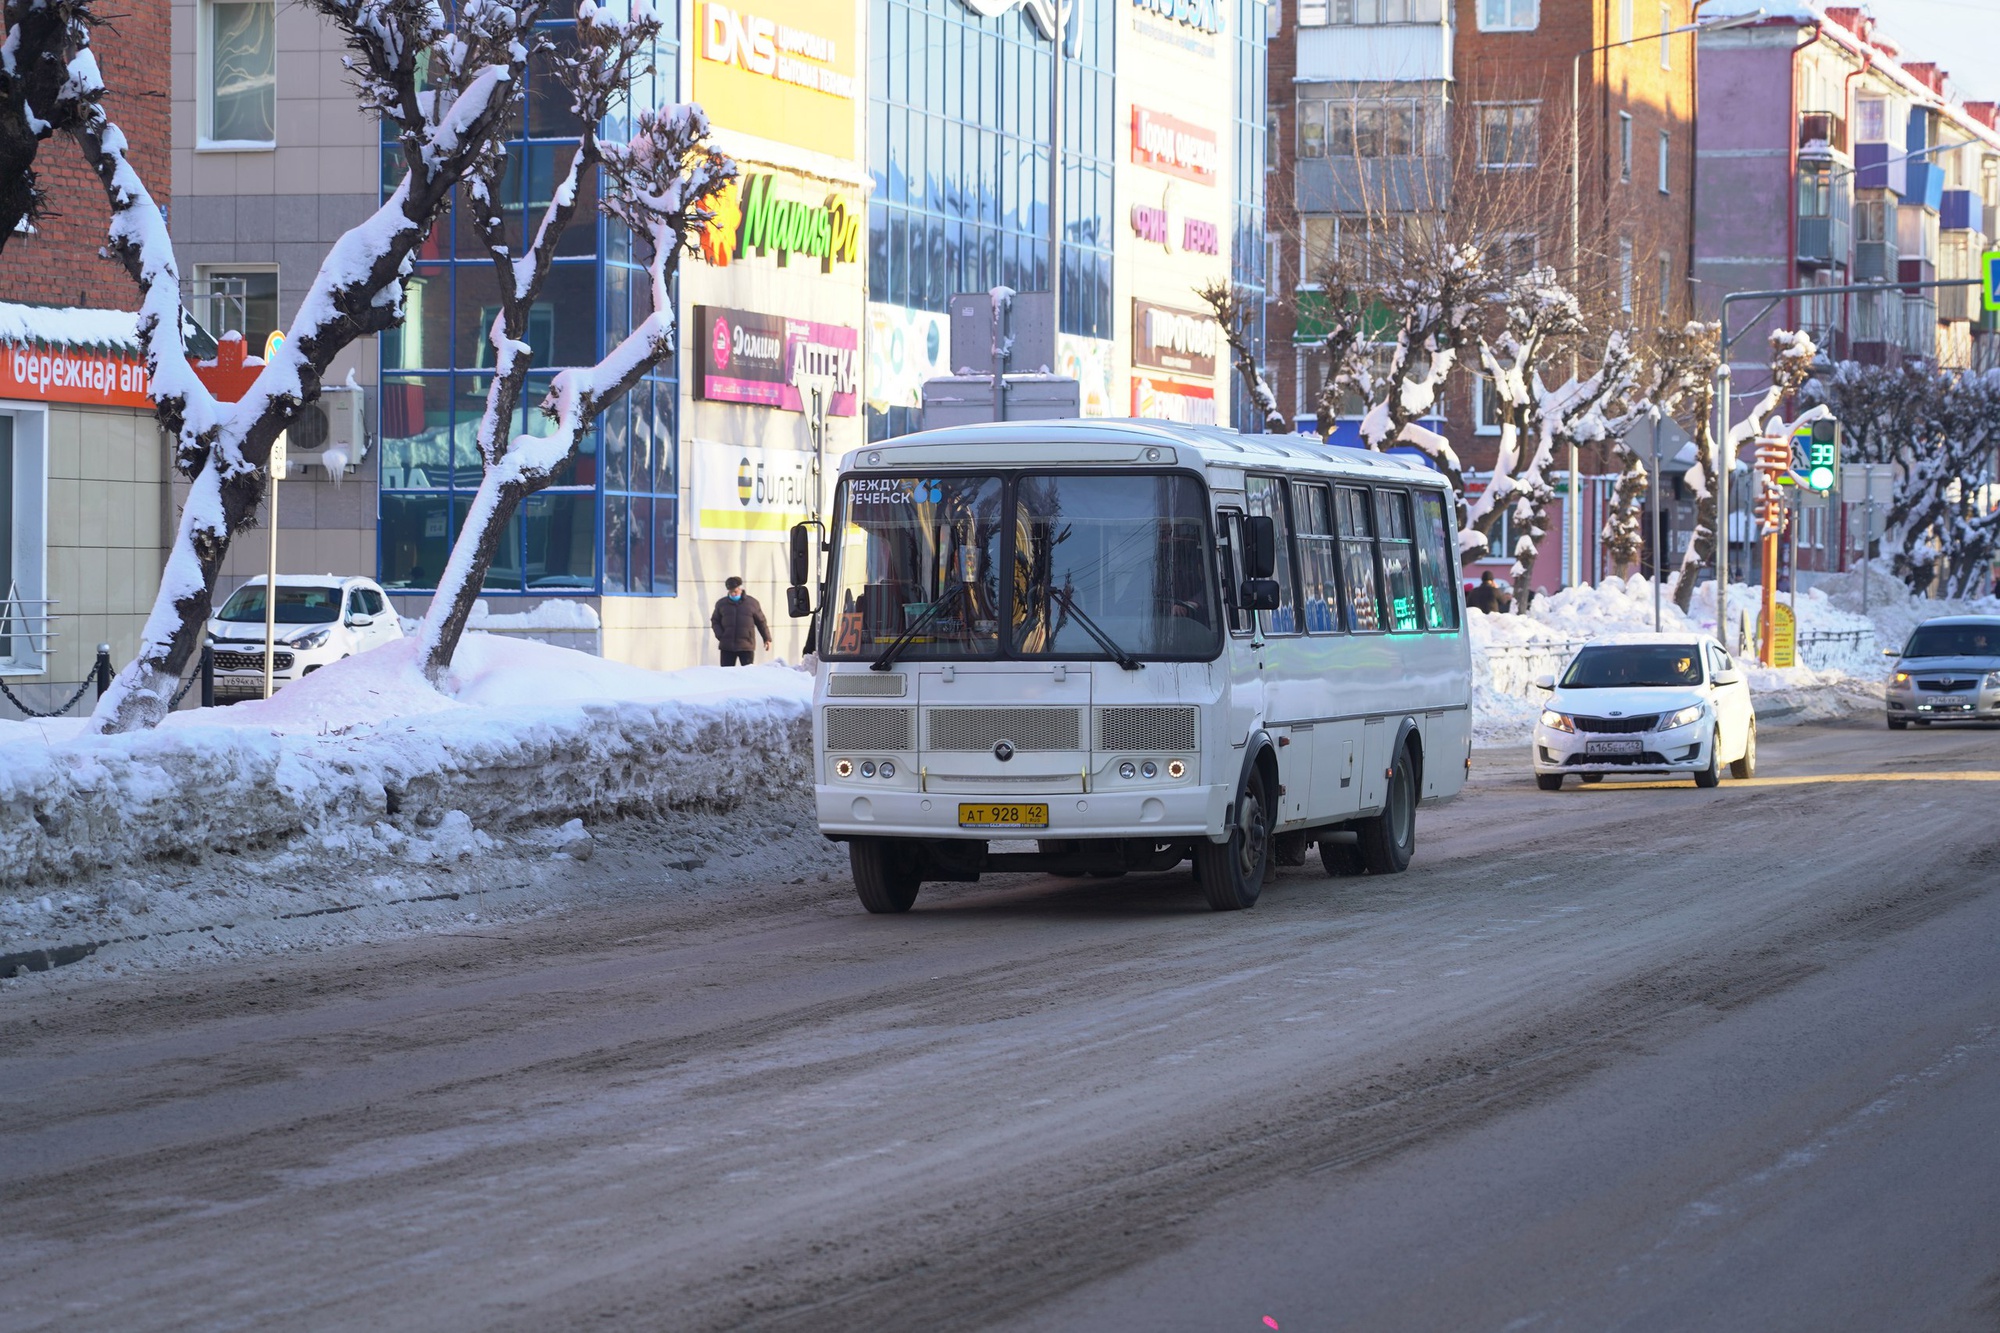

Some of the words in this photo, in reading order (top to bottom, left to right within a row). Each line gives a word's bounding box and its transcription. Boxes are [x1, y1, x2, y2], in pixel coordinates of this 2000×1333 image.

[702, 2, 775, 77] DNS
[1139, 110, 1175, 163] Город
[1183, 217, 1218, 255] ТЕРРА
[791, 341, 858, 394] АПТЕКА
[1811, 444, 1834, 465] 39
[757, 463, 804, 506] билай
[850, 480, 900, 491] МЕЖДУ
[837, 617, 861, 651] 25
[967, 810, 984, 822] АТ
[991, 807, 1019, 822] 928
[1028, 806, 1042, 818] 42
